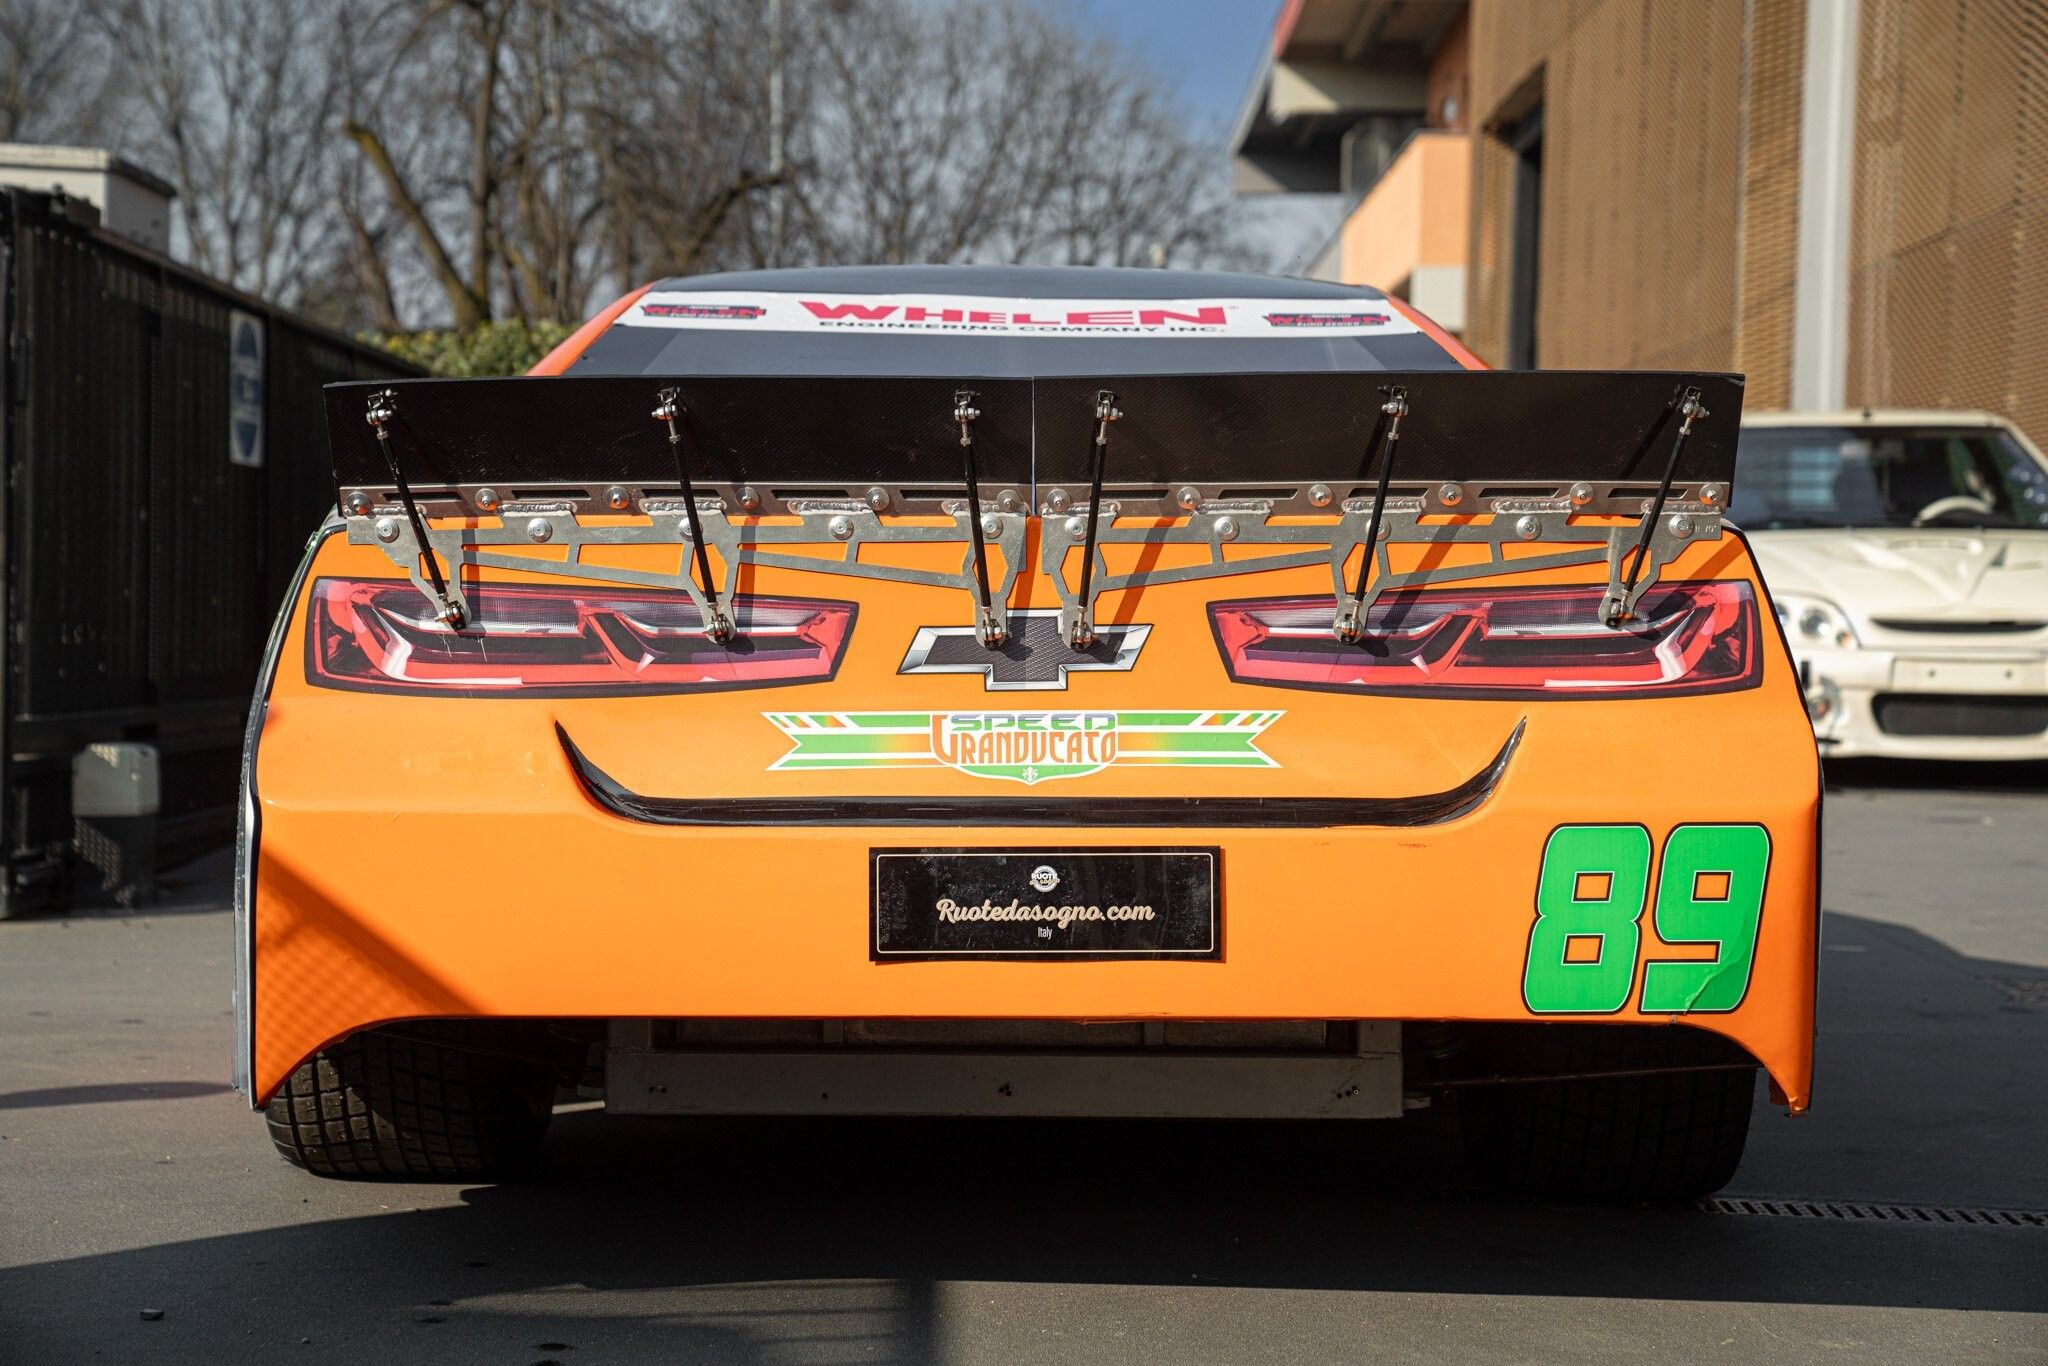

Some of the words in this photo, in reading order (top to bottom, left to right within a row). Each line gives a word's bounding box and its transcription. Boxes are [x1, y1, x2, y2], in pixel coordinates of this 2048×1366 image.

[798, 301, 1227, 325] WHELEN
[819, 321, 1008, 331] ENGINEERING
[950, 713, 1115, 731] SPEED
[936, 898, 1156, 930] Ruotedasogno.com
[1520, 822, 1774, 1015] 89
[1037, 926, 1053, 940] Italy
